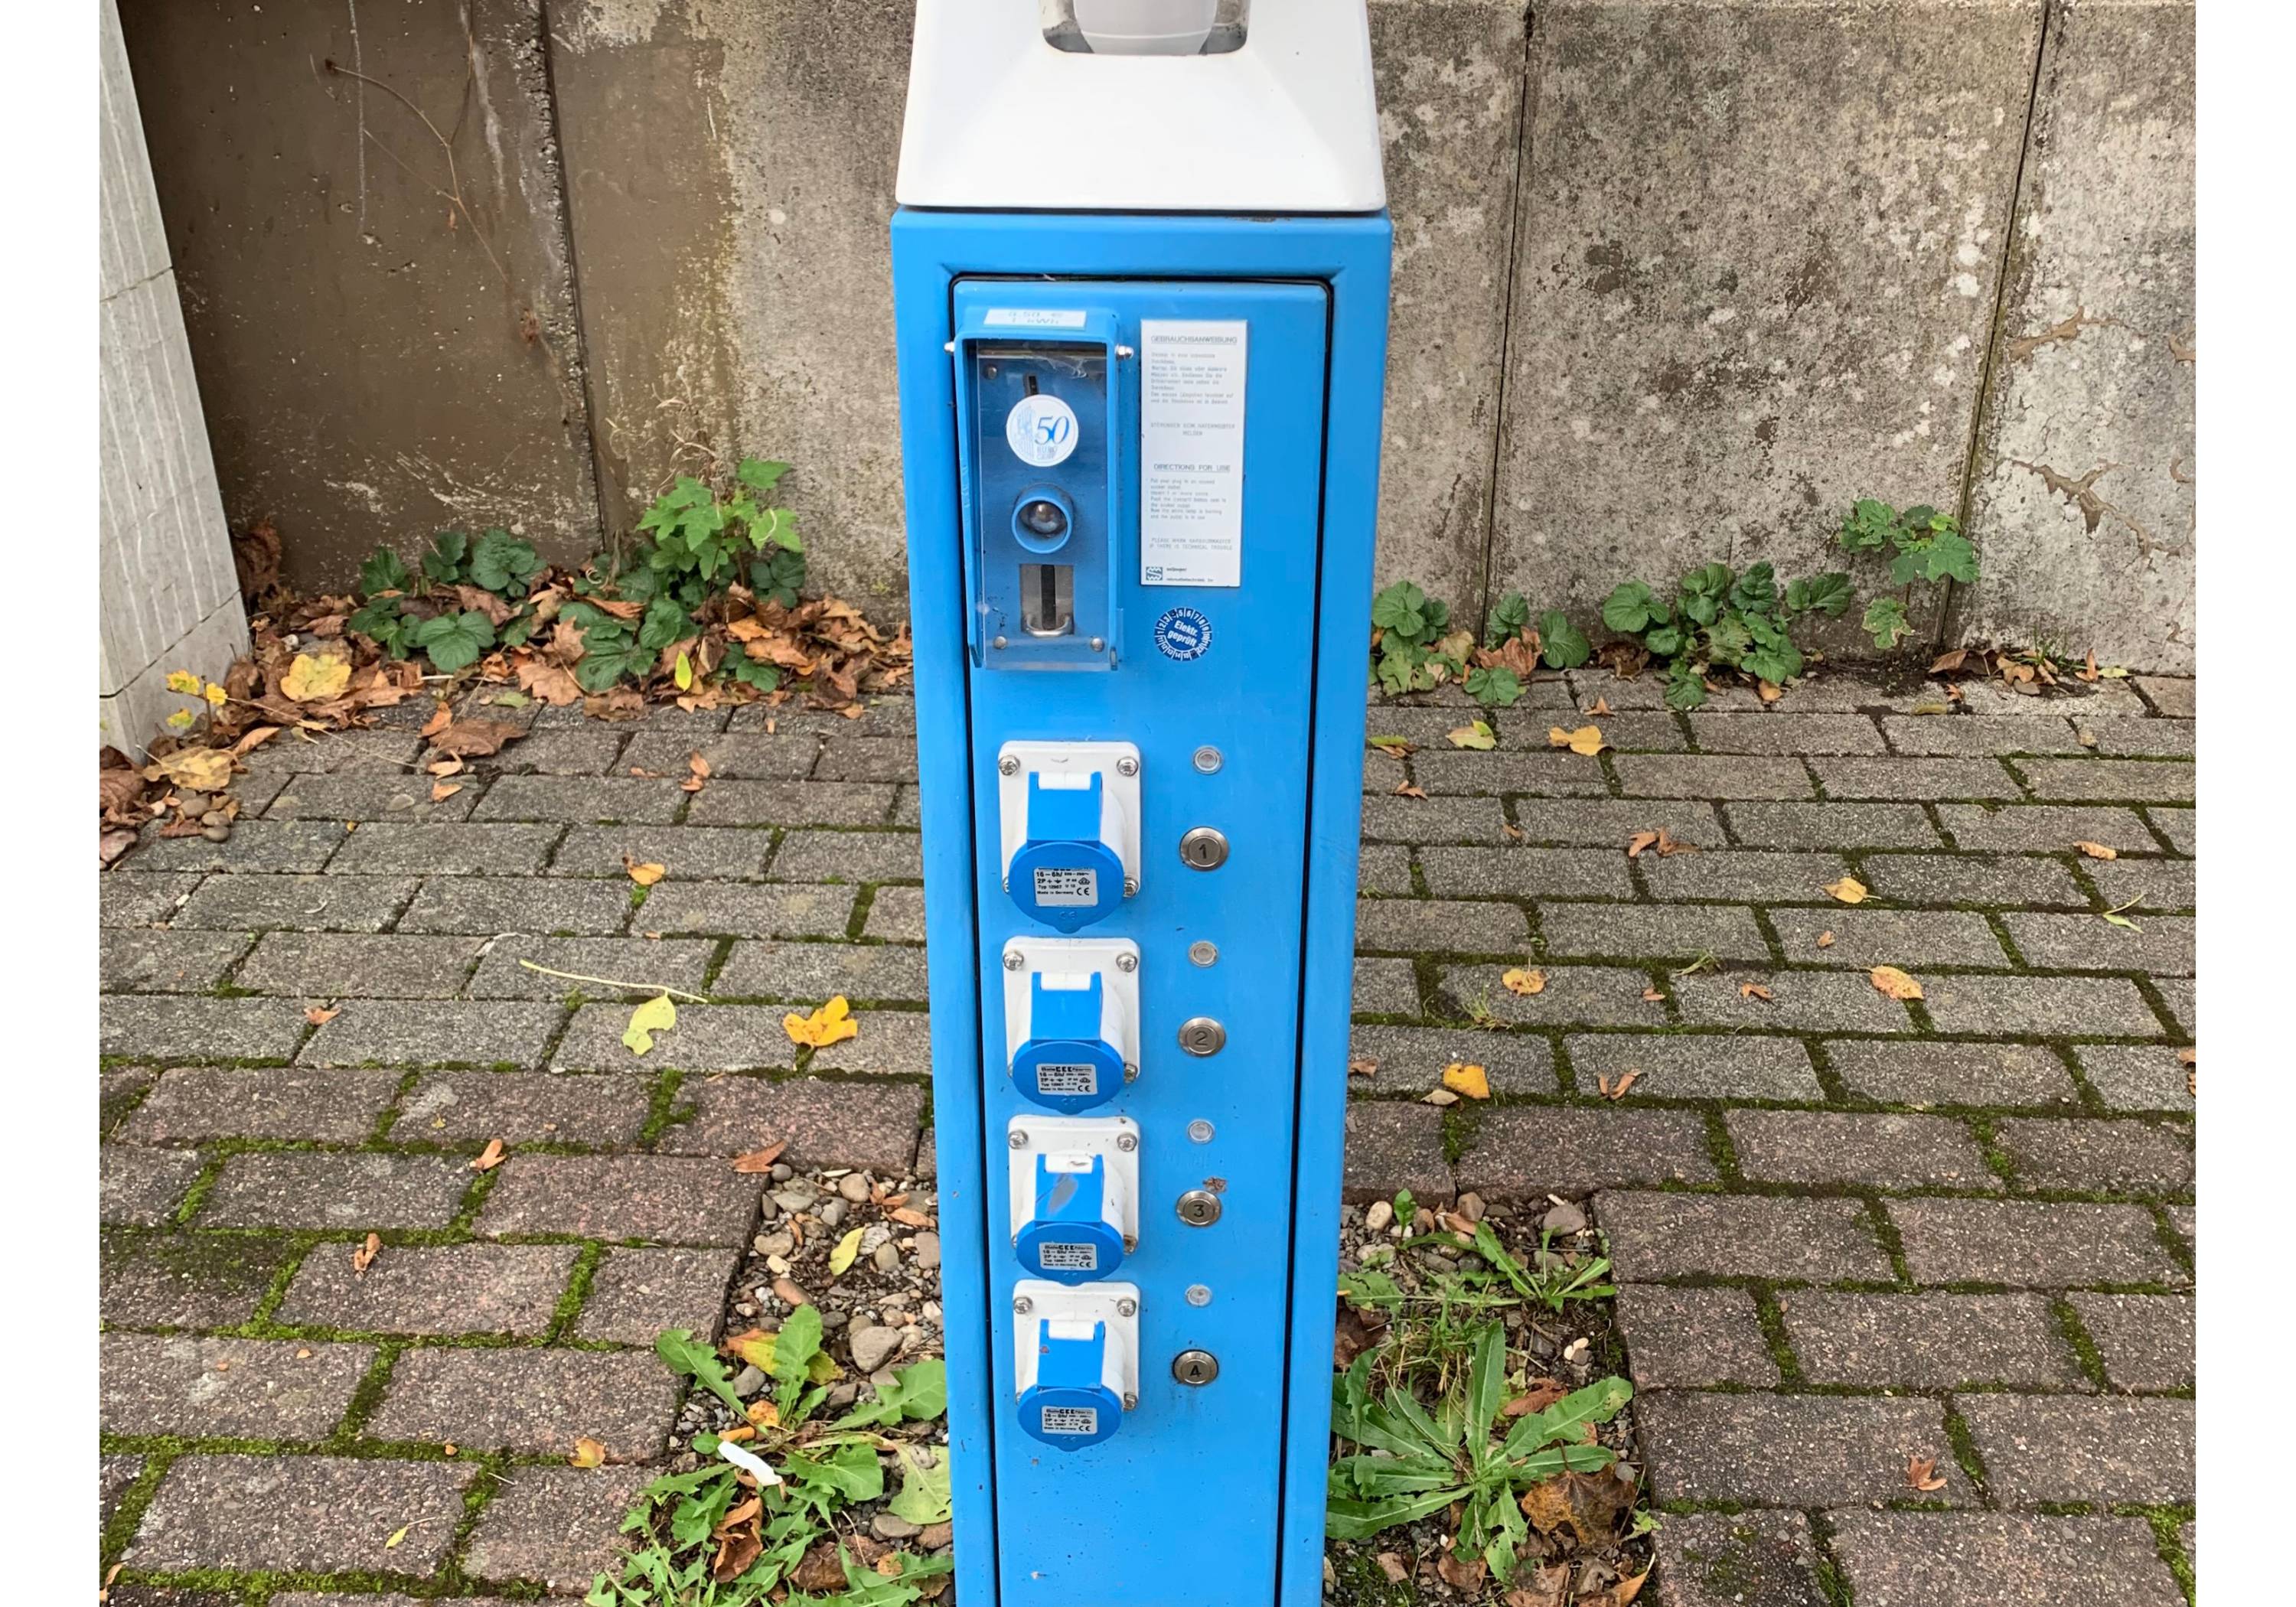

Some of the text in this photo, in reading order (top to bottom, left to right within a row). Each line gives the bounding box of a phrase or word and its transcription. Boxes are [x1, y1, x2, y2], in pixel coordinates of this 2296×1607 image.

[1034, 416, 1070, 445] 50
[1174, 620, 1199, 637] Elektr.
[1199, 844, 1207, 859] 1
[1076, 888, 1090, 896] CE
[1195, 1030, 1208, 1046] 2
[1193, 1204, 1205, 1218] 3
[1189, 1364, 1202, 1377] 4
